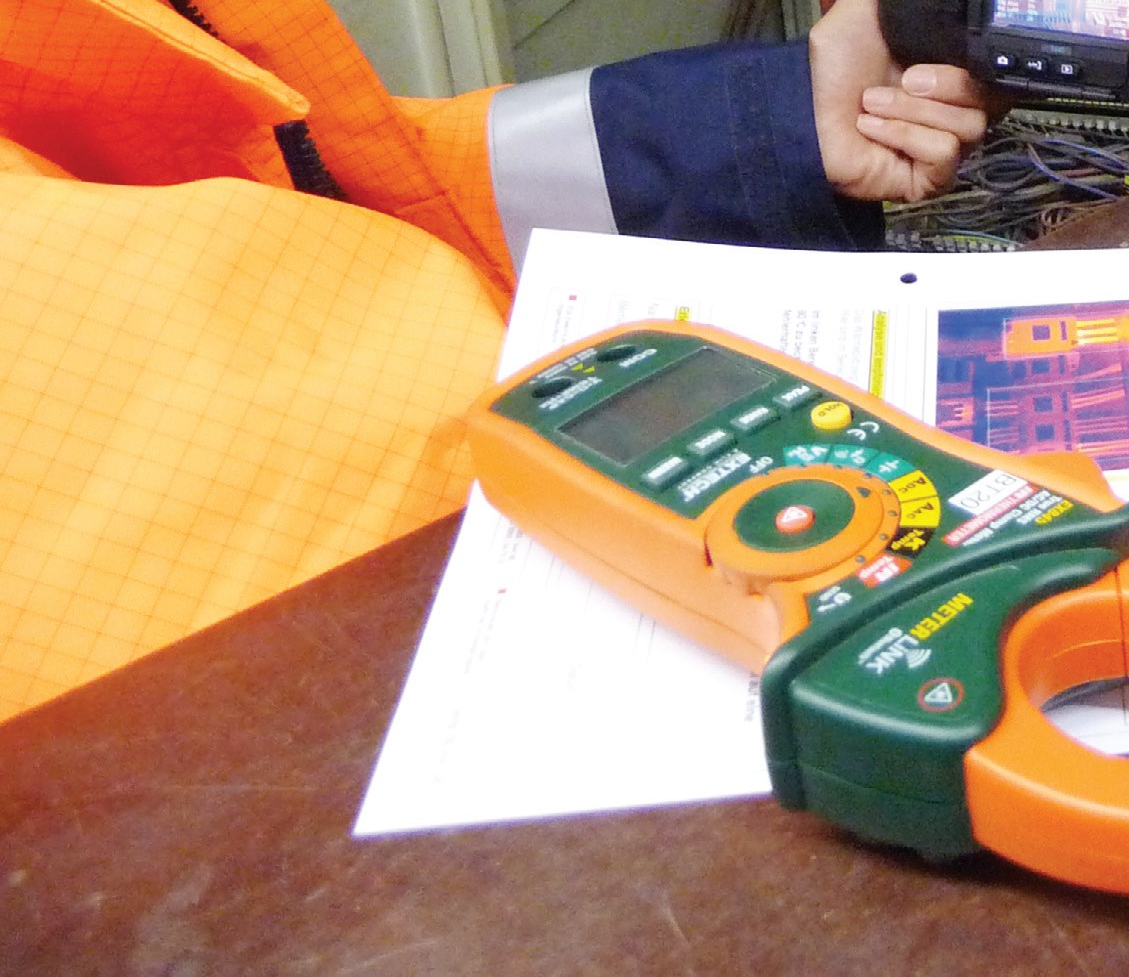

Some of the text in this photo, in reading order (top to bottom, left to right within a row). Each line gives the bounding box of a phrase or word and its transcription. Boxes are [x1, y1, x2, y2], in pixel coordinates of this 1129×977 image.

[818, 402, 843, 417] HOLD
[682, 450, 751, 502] EXTECH
[750, 456, 773, 474] OFF
[960, 474, 1016, 509] BT20
[874, 560, 899, 582] IR
